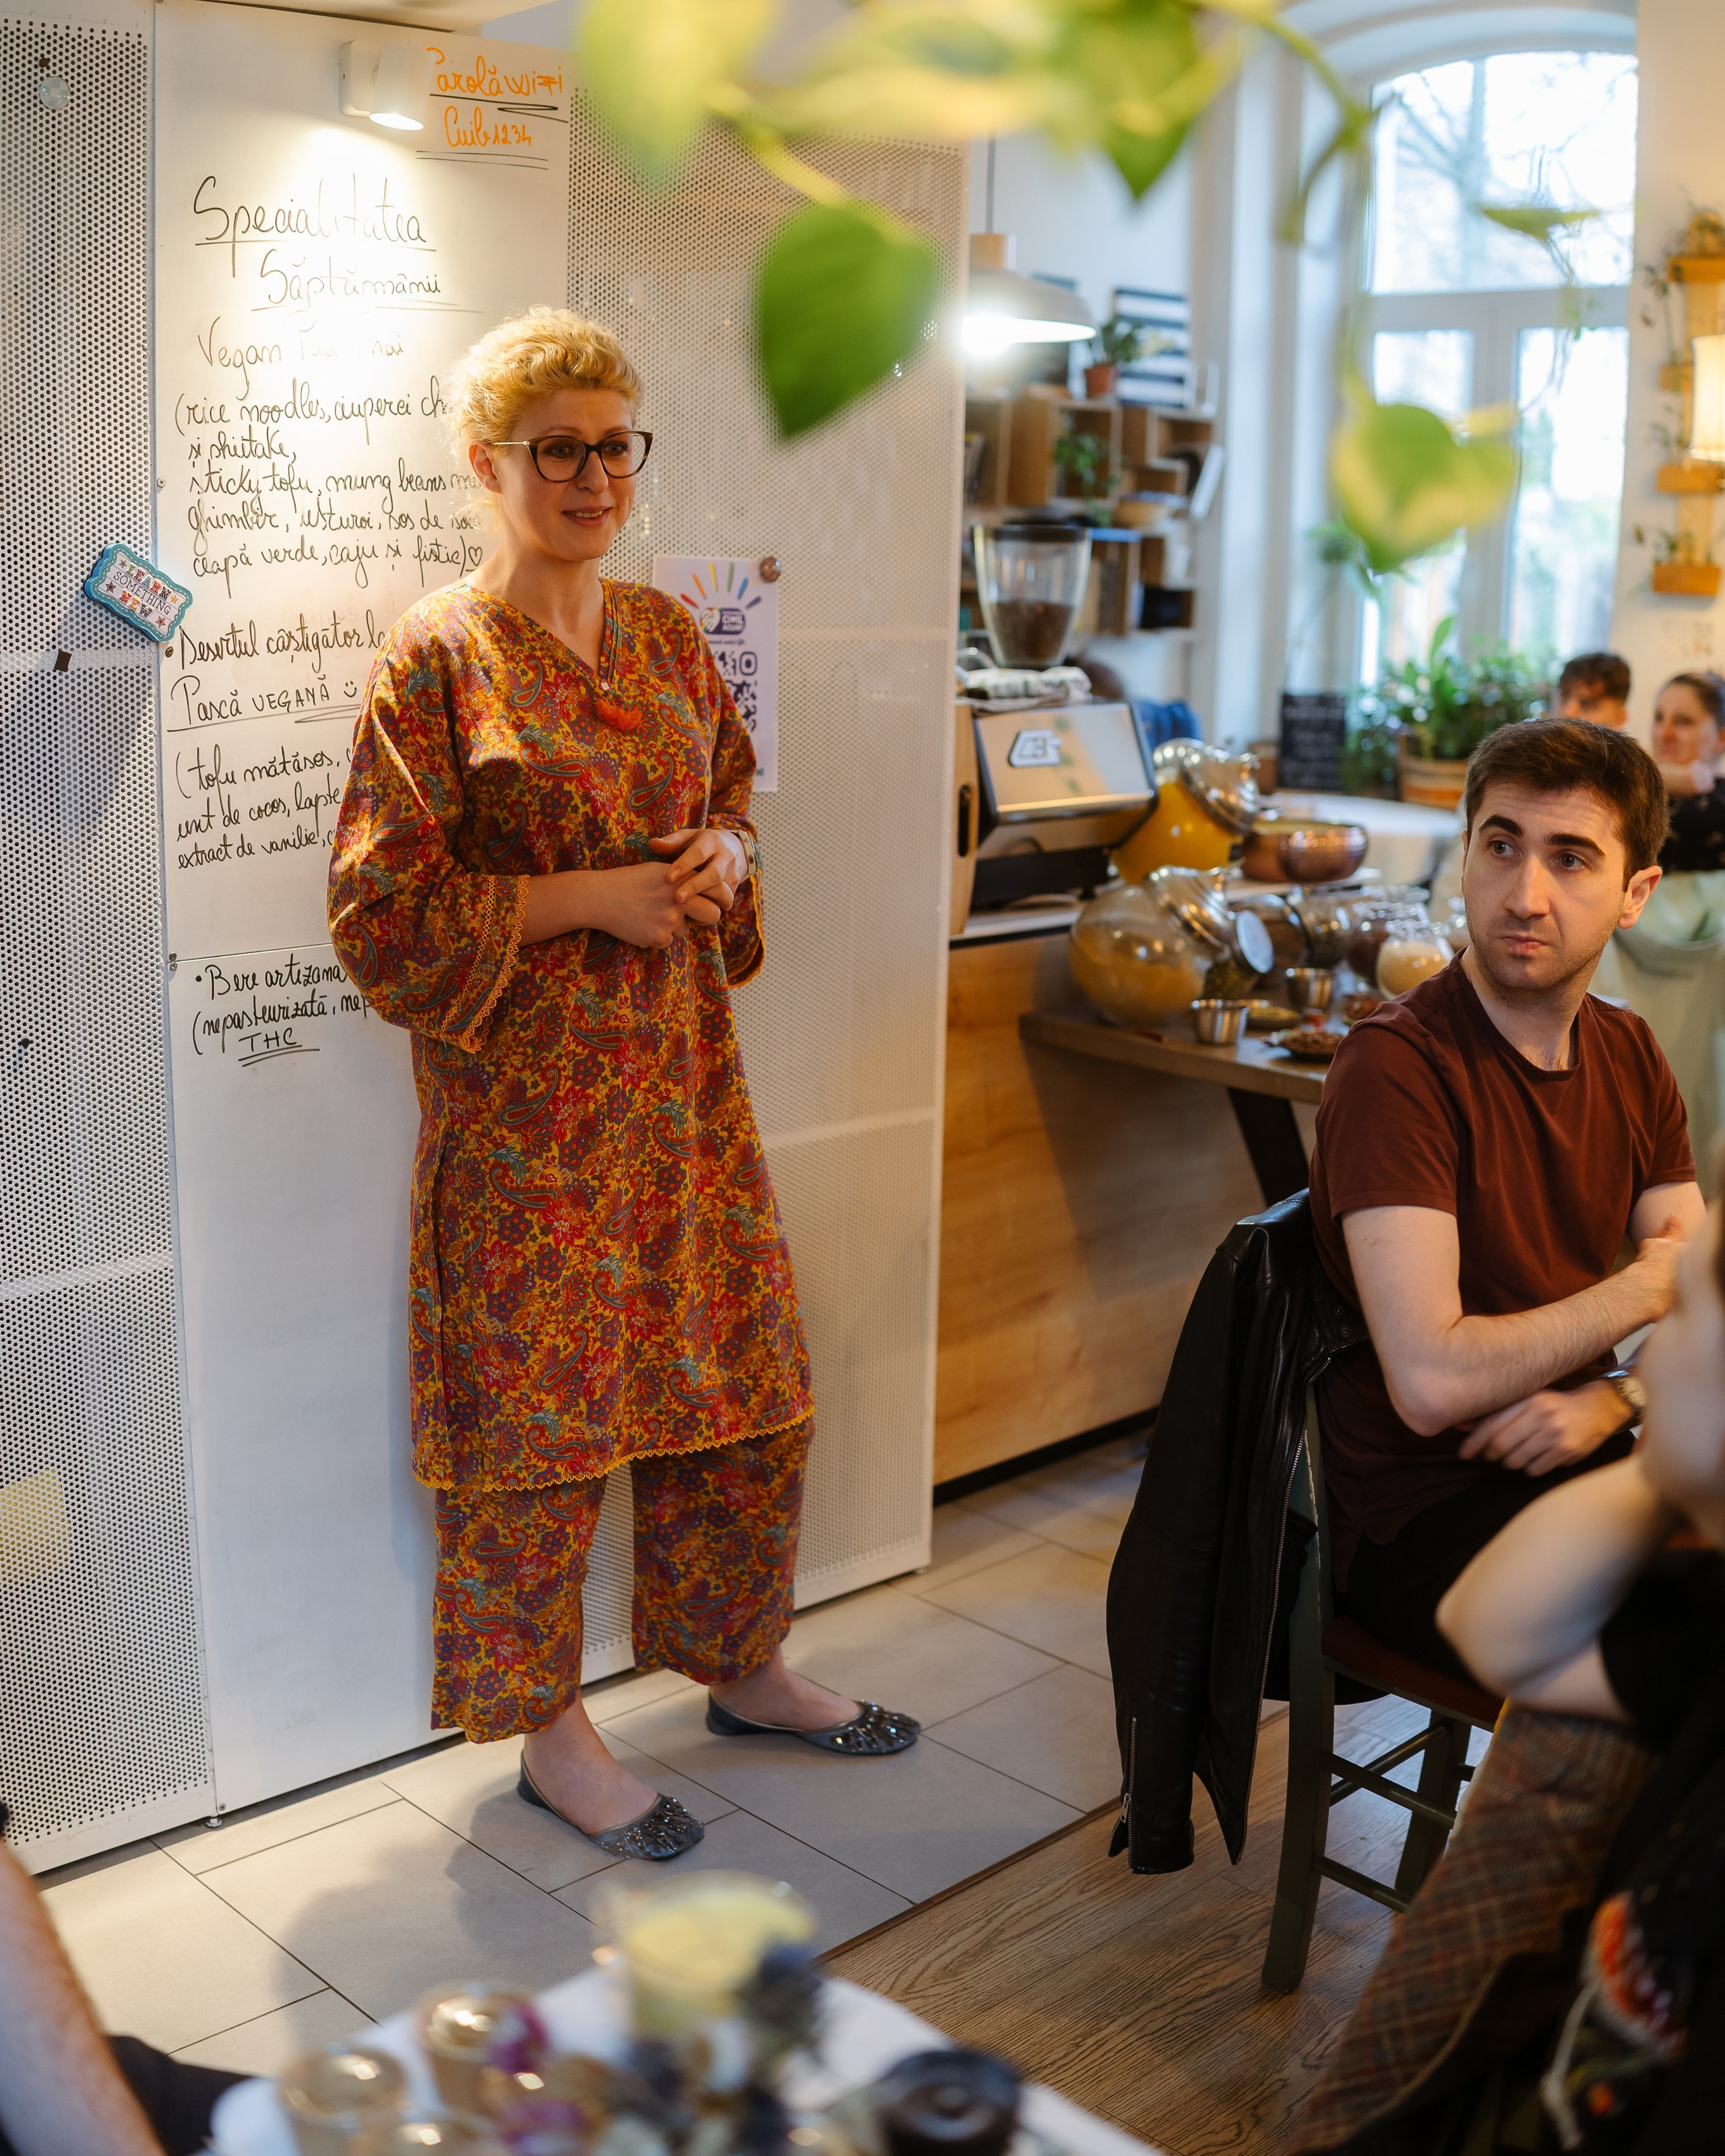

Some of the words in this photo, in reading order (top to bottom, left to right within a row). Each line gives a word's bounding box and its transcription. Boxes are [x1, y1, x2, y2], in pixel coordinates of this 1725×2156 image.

[193, 173, 427, 278] Specialitatea
[197, 317, 281, 400] Vegan
[175, 393, 230, 437] (rice
[325, 474, 394, 514] mung
[398, 457, 446, 492] beans
[389, 513, 415, 530] sos
[420, 499, 443, 530] de
[113, 571, 171, 616] SOMETHING
[126, 563, 172, 600] LEARN
[193, 543, 252, 599] ceapă
[119, 589, 154, 618] NEW
[180, 619, 259, 669] Desertul
[170, 675, 243, 725] Pască
[252, 674, 330, 713] VEGANĂ
[222, 794, 241, 827] de
[294, 772, 342, 837] lapte
[178, 833, 234, 869] extract
[237, 833, 255, 858] de
[205, 964, 259, 1001] Bere
[239, 1027, 296, 1052] THC
